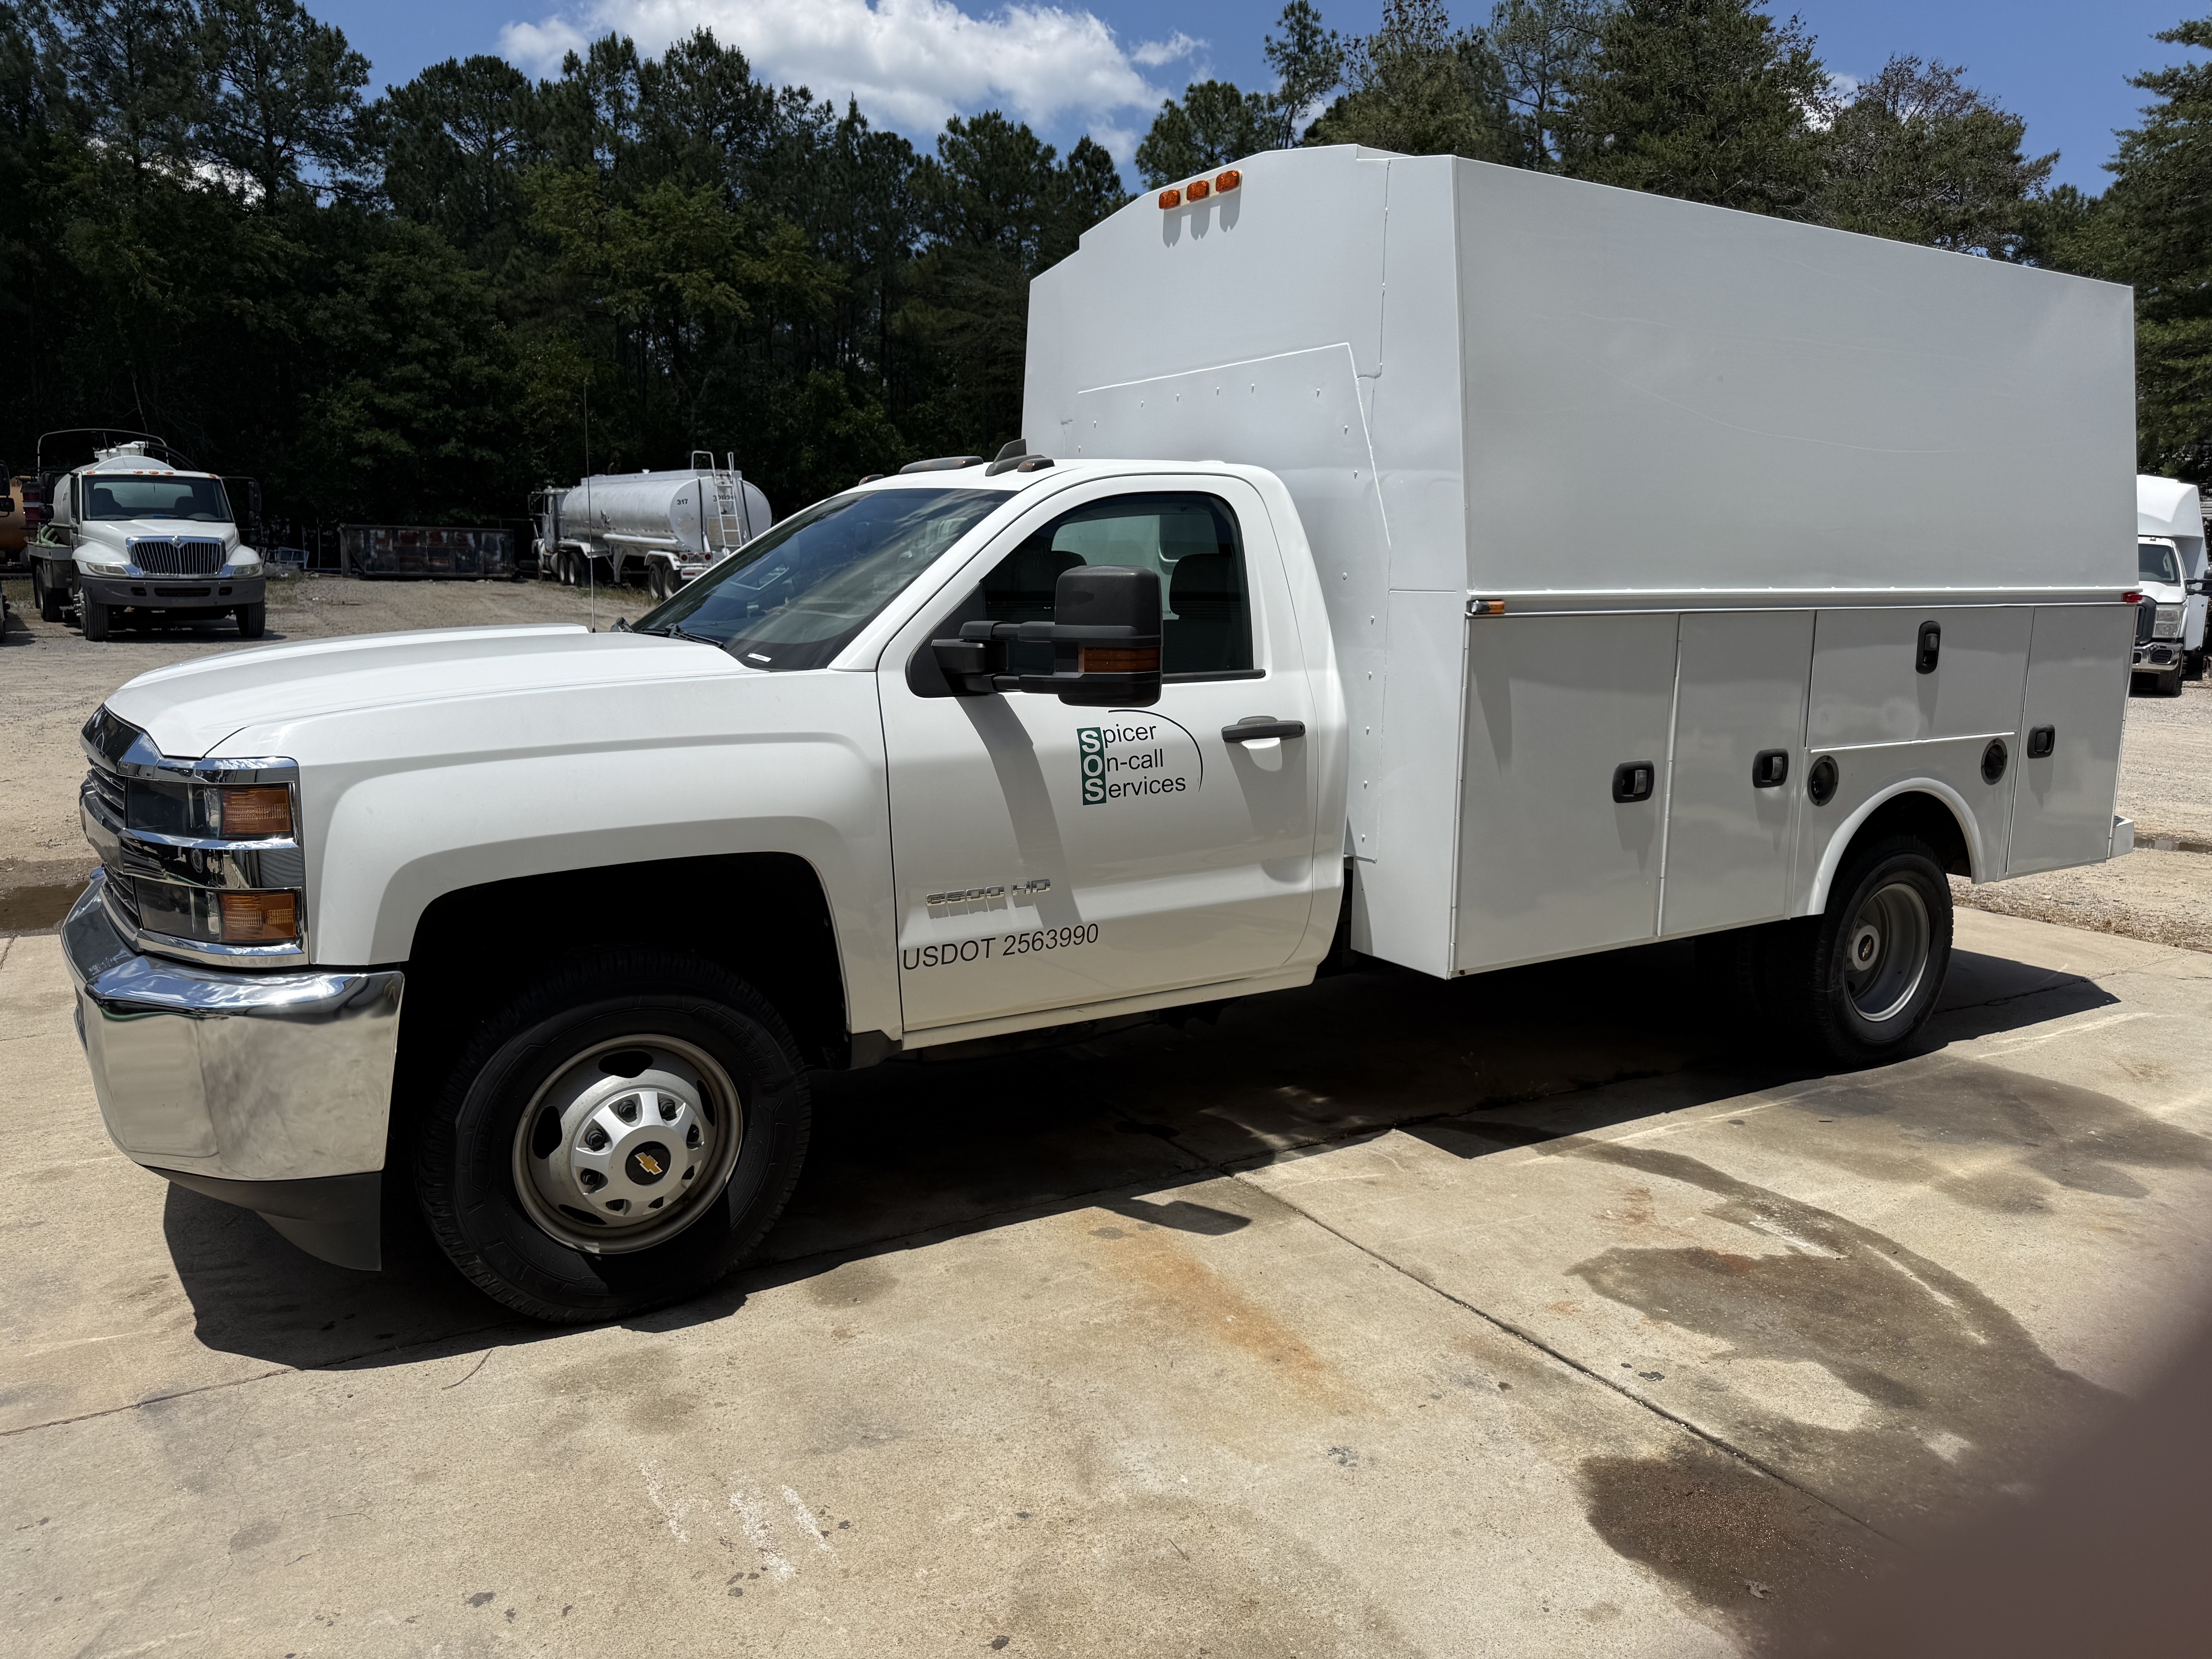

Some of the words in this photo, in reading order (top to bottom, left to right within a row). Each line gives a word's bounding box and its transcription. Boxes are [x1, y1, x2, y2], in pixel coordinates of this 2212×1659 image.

[1080, 724, 1156, 753] Spicer
[1083, 748, 1163, 777] On-call
[1085, 776, 1186, 802] Services
[926, 885, 1005, 906] 3500
[1012, 879, 1051, 896] HD
[903, 937, 996, 970] USDOT
[1003, 923, 1099, 956] 2563990
